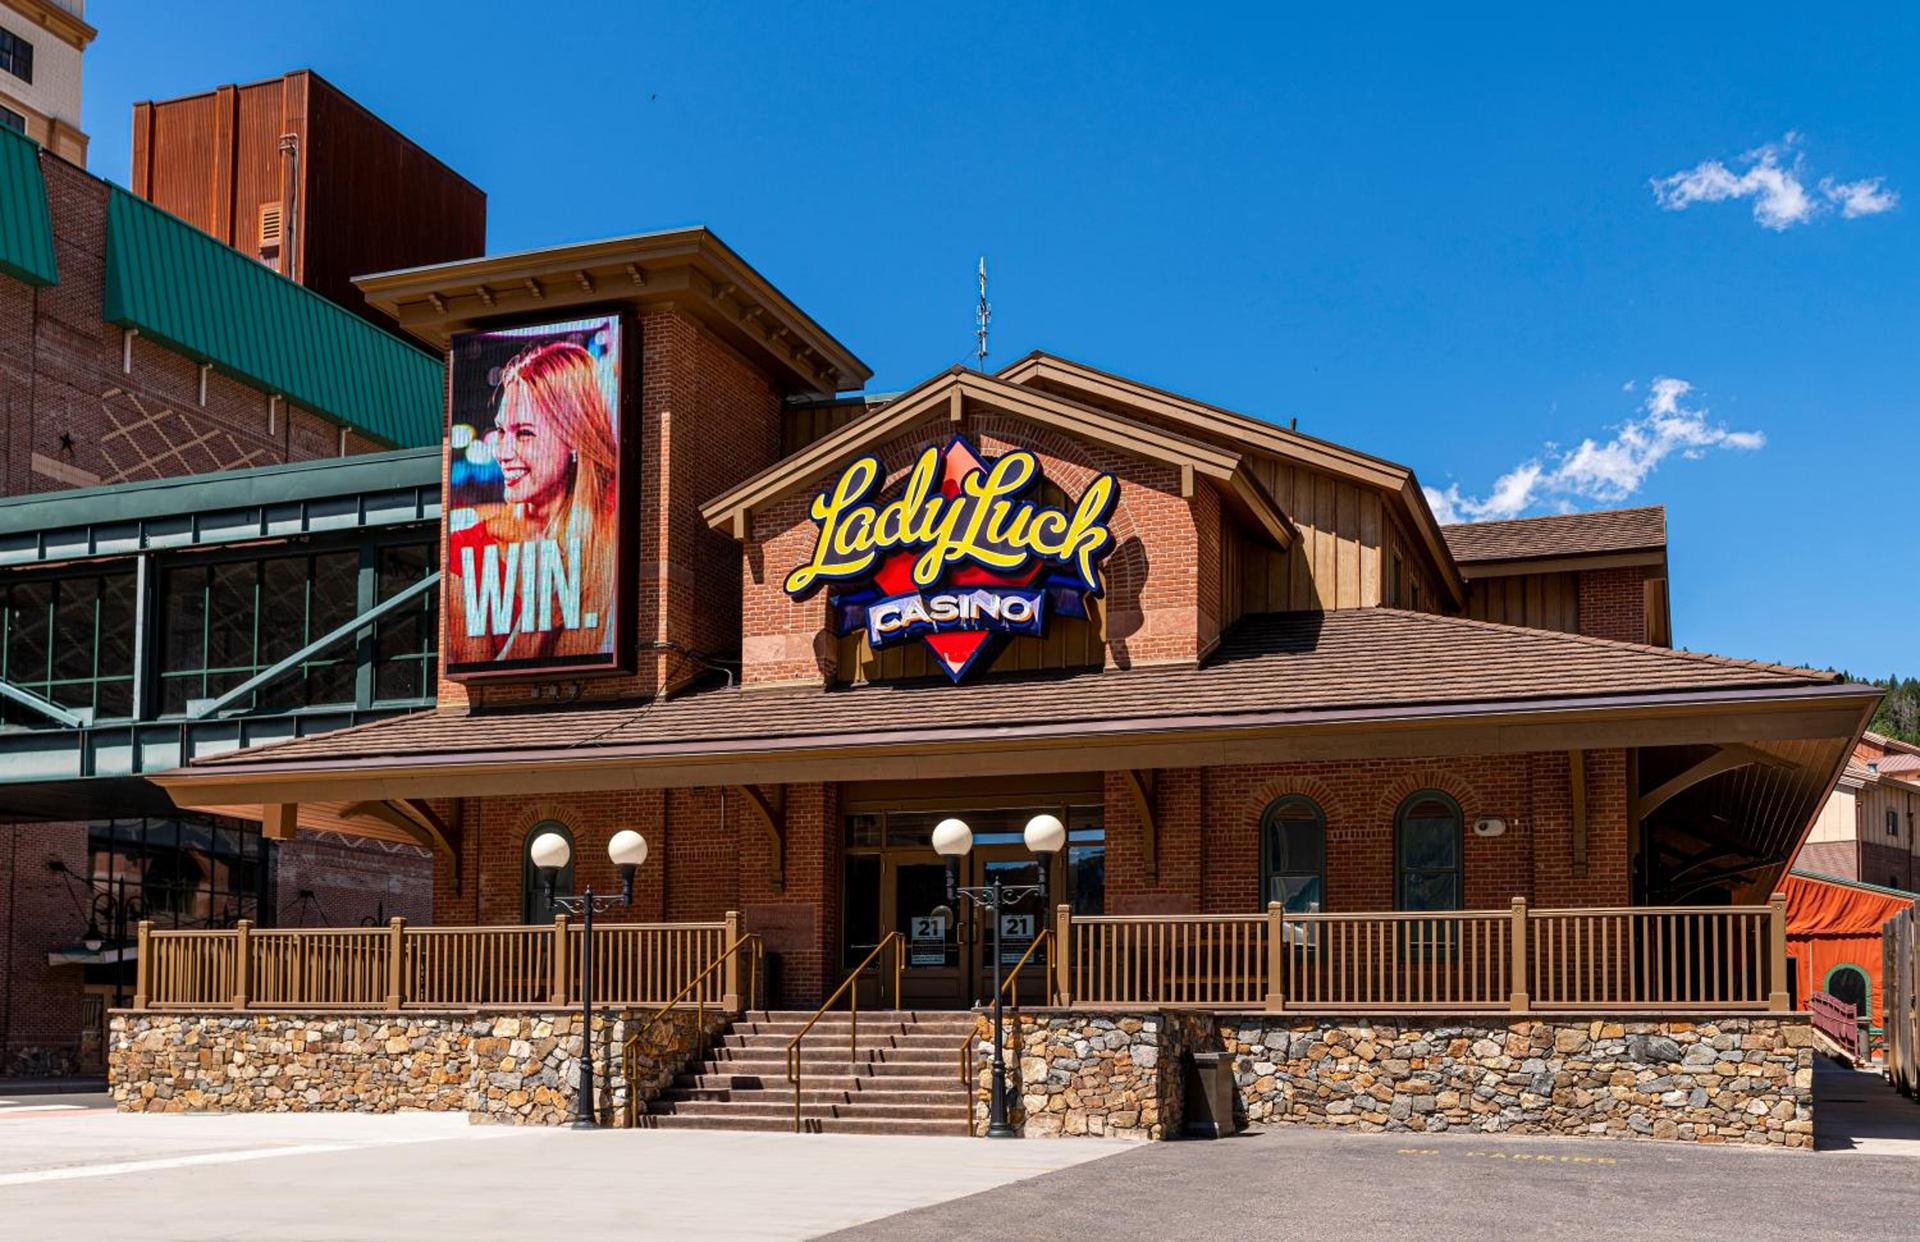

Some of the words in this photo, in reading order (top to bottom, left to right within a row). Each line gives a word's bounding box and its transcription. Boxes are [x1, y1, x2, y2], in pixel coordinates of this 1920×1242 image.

[783, 446, 966, 593] Lady
[945, 451, 1113, 589] Luck
[461, 537, 598, 638] WIN.
[875, 592, 1034, 632] CASINO
[918, 919, 938, 937] 21
[1007, 918, 1027, 935] 21
